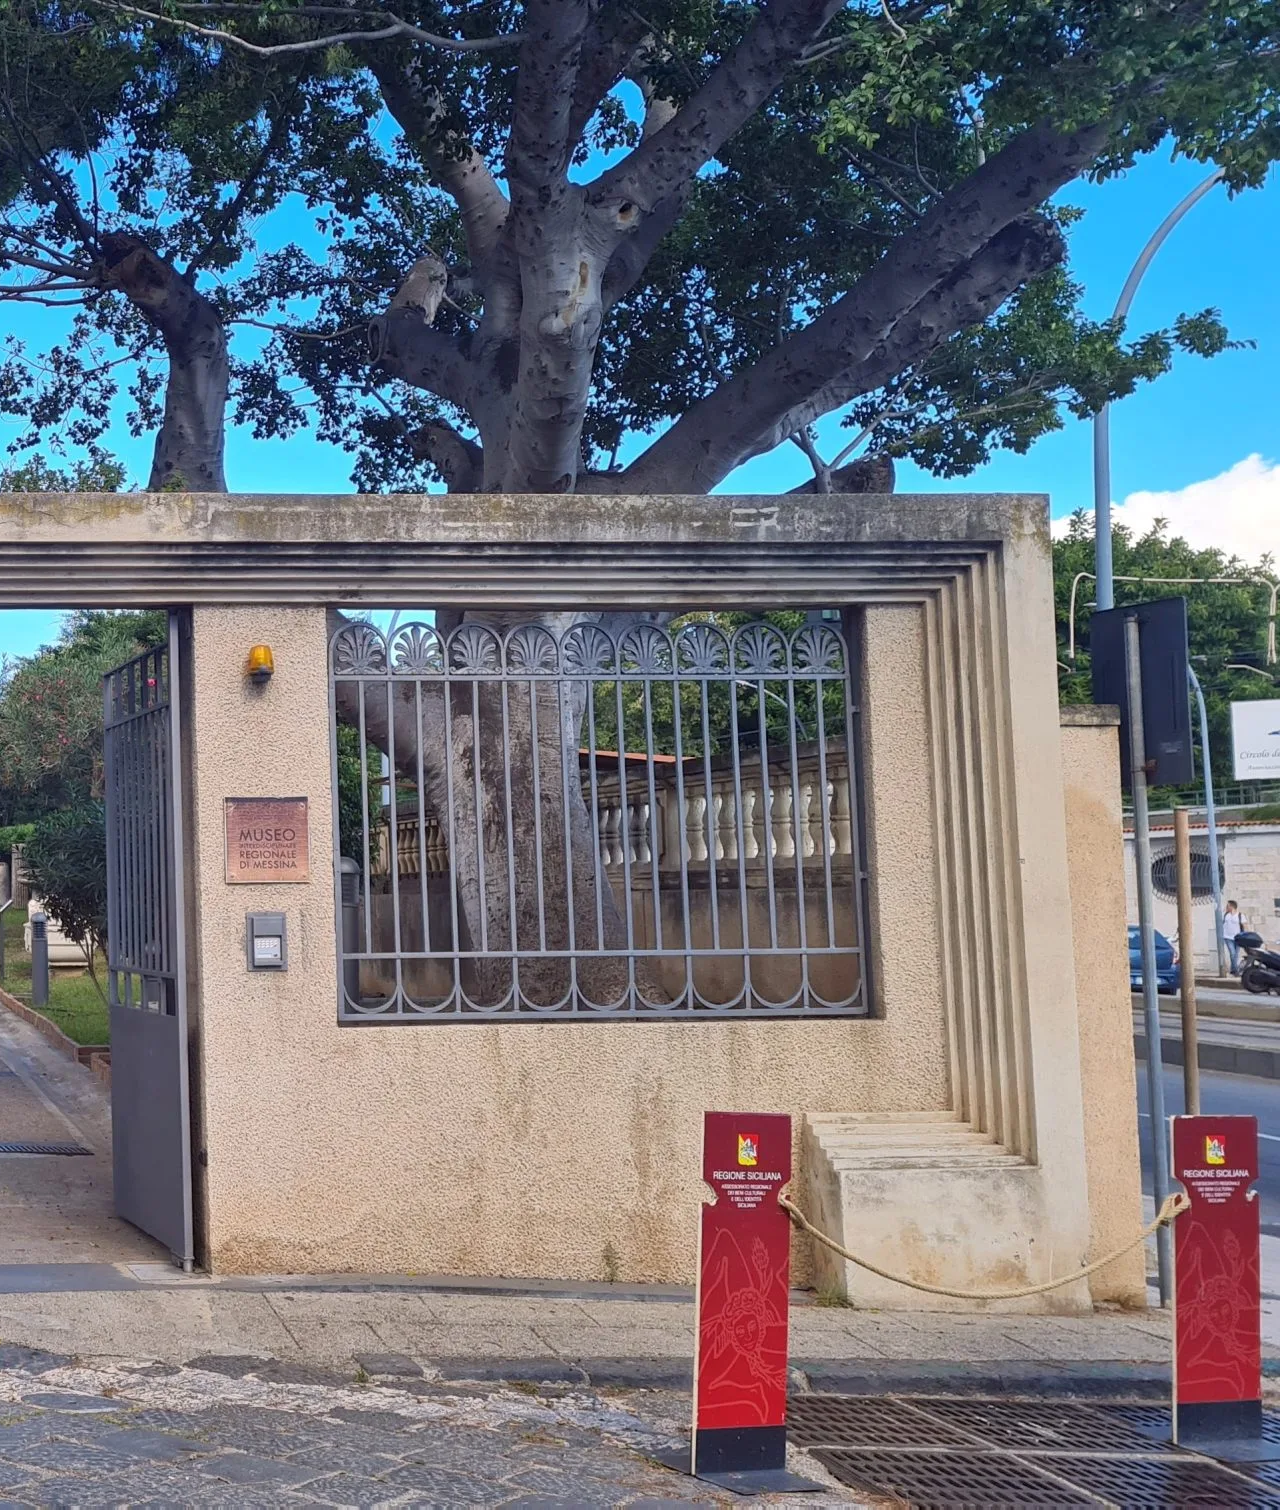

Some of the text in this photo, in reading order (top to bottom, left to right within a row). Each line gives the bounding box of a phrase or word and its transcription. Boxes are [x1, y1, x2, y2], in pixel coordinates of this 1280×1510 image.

[239, 828, 296, 841] MUSEO
[239, 850, 297, 859] REGIONALE
[239, 860, 298, 869] DI MESSINA
[713, 1171, 782, 1180] REGIONE SICILIANA
